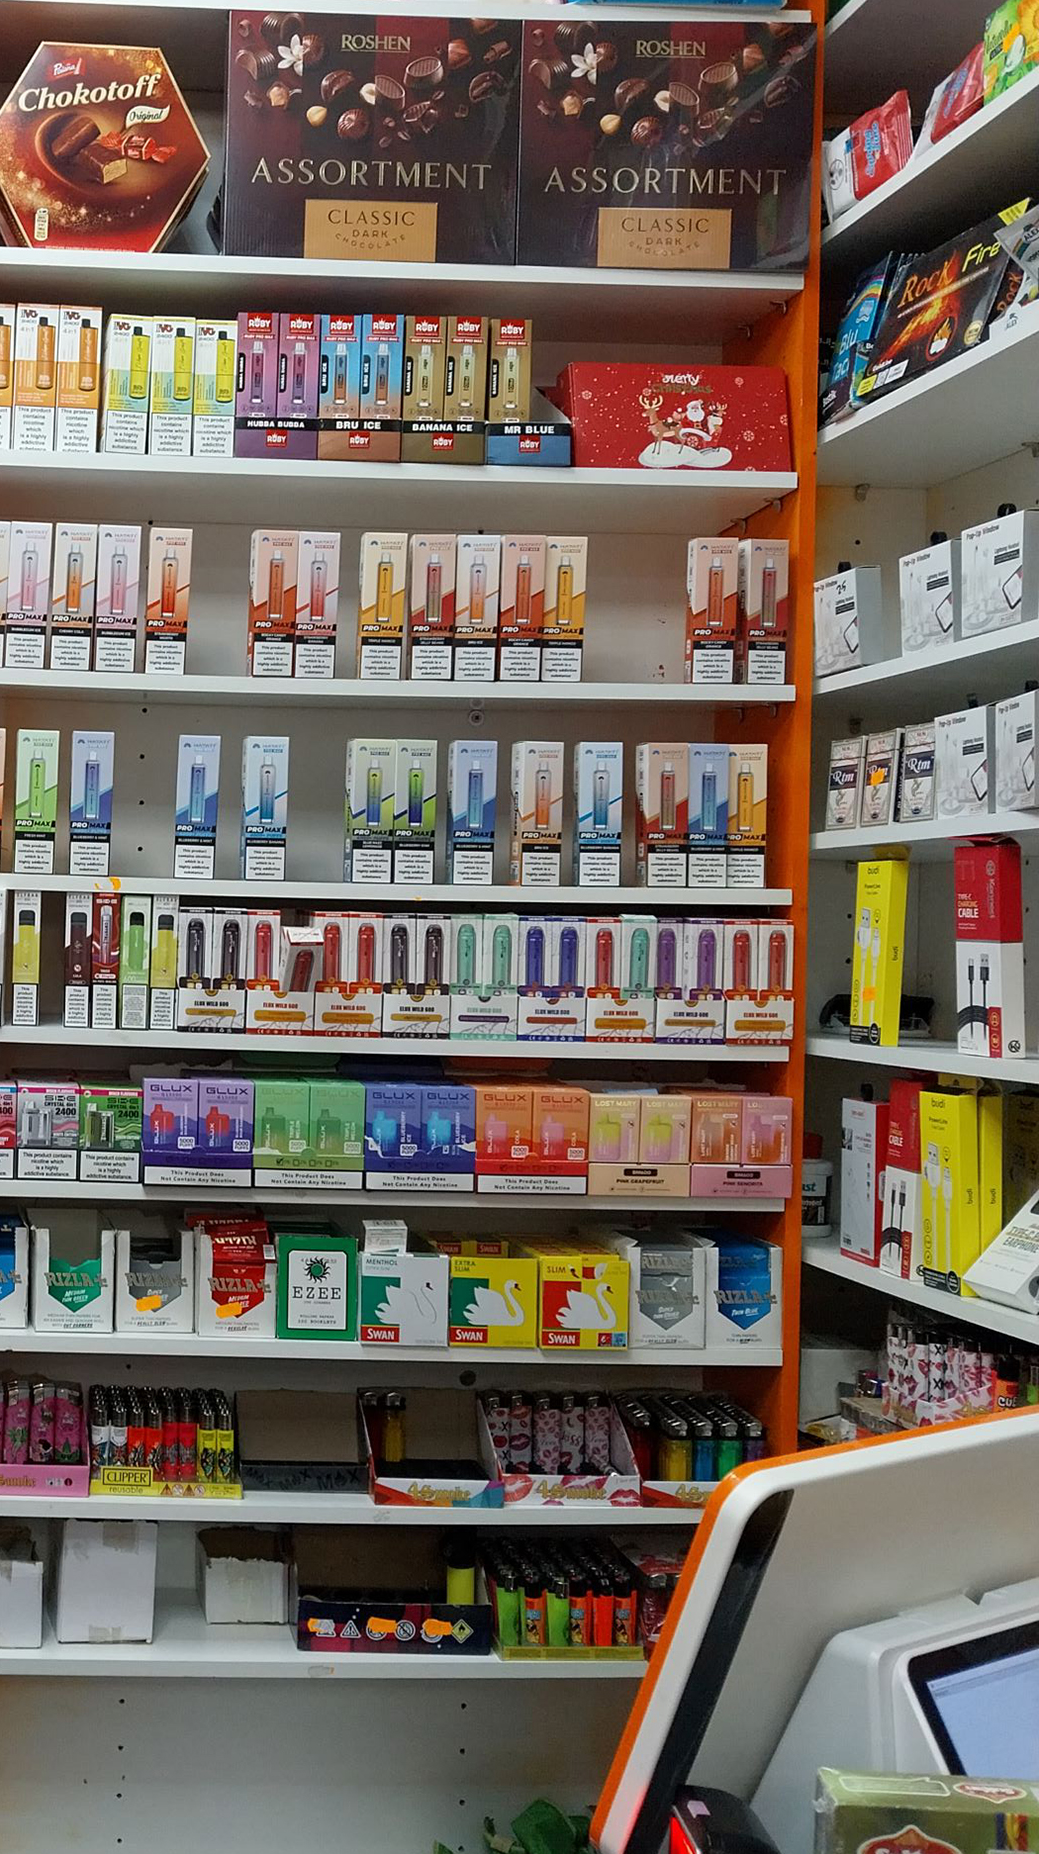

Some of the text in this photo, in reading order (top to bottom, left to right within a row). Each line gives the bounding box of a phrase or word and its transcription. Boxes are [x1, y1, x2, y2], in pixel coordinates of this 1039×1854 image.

[341, 35, 411, 51] ROSHEN
[636, 40, 706, 56] ROSHEN
[18, 74, 162, 112] Chokotoff
[129, 109, 164, 124] Original
[251, 158, 493, 191] ASSORTMENT
[544, 168, 788, 197] ASSORTMENT
[327, 209, 416, 228] CLASSIC
[620, 216, 711, 235] CLASSIC
[351, 228, 389, 240] DARK
[334, 233, 407, 250] CHOCOLATE
[645, 236, 683, 248] DARK
[248, 318, 271, 330] RUBY
[330, 320, 354, 332] RUBY
[501, 324, 524, 336] RUBY
[246, 419, 306, 429] HUBBA BUBBA
[335, 420, 382, 431] BRU ICE
[411, 422, 474, 433] BANANA ICE
[504, 424, 555, 435] MR BLUE
[907, 758, 931, 772] Rtm
[833, 770, 855, 785] Rtm
[957, 908, 979, 919] CABLE
[149, 1084, 193, 1094] GLUX
[205, 1086, 249, 1096] GLUX
[372, 1092, 416, 1102] GLUX
[930, 1097, 946, 1109] budi
[118, 1110, 139, 1119] 2400
[365, 1259, 398, 1267] MENTHOL
[546, 1266, 567, 1274] SLIM
[291, 1285, 343, 1300] EZEE
[366, 1328, 395, 1341] SWAN
[455, 1329, 483, 1342] SWAN
[548, 1332, 576, 1345] SWAN
[106, 1470, 149, 1484] CLIPPER
[109, 1486, 143, 1495] reusable
